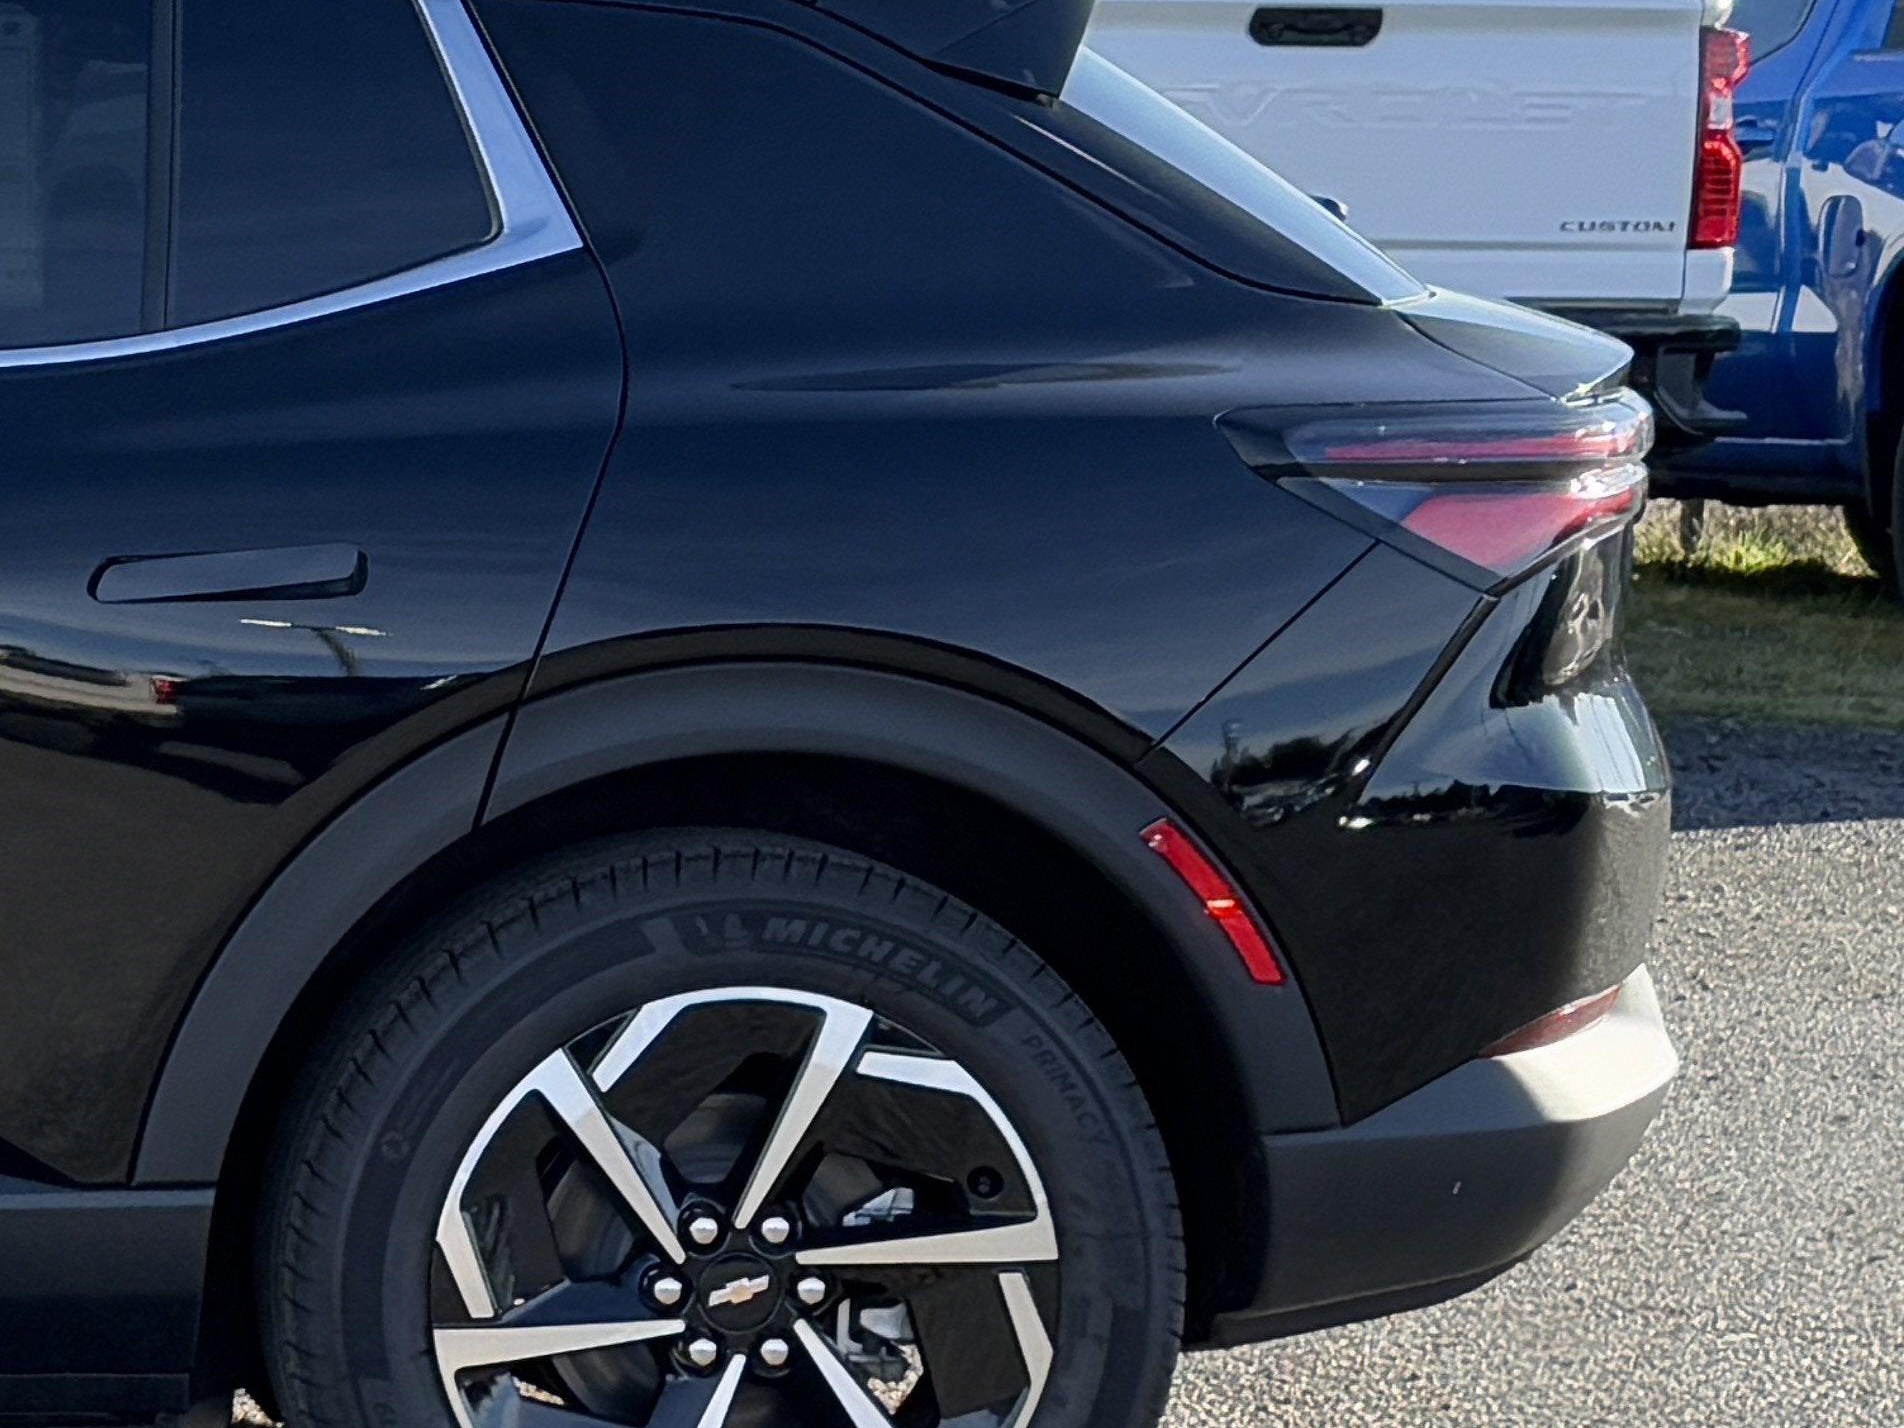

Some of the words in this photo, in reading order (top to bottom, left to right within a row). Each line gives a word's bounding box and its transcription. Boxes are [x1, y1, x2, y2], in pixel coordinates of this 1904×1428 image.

[1559, 220, 1675, 232] CUSTOM
[762, 915, 996, 1019] MICHELIN
[1023, 1034, 1111, 1148] PRIMACY
